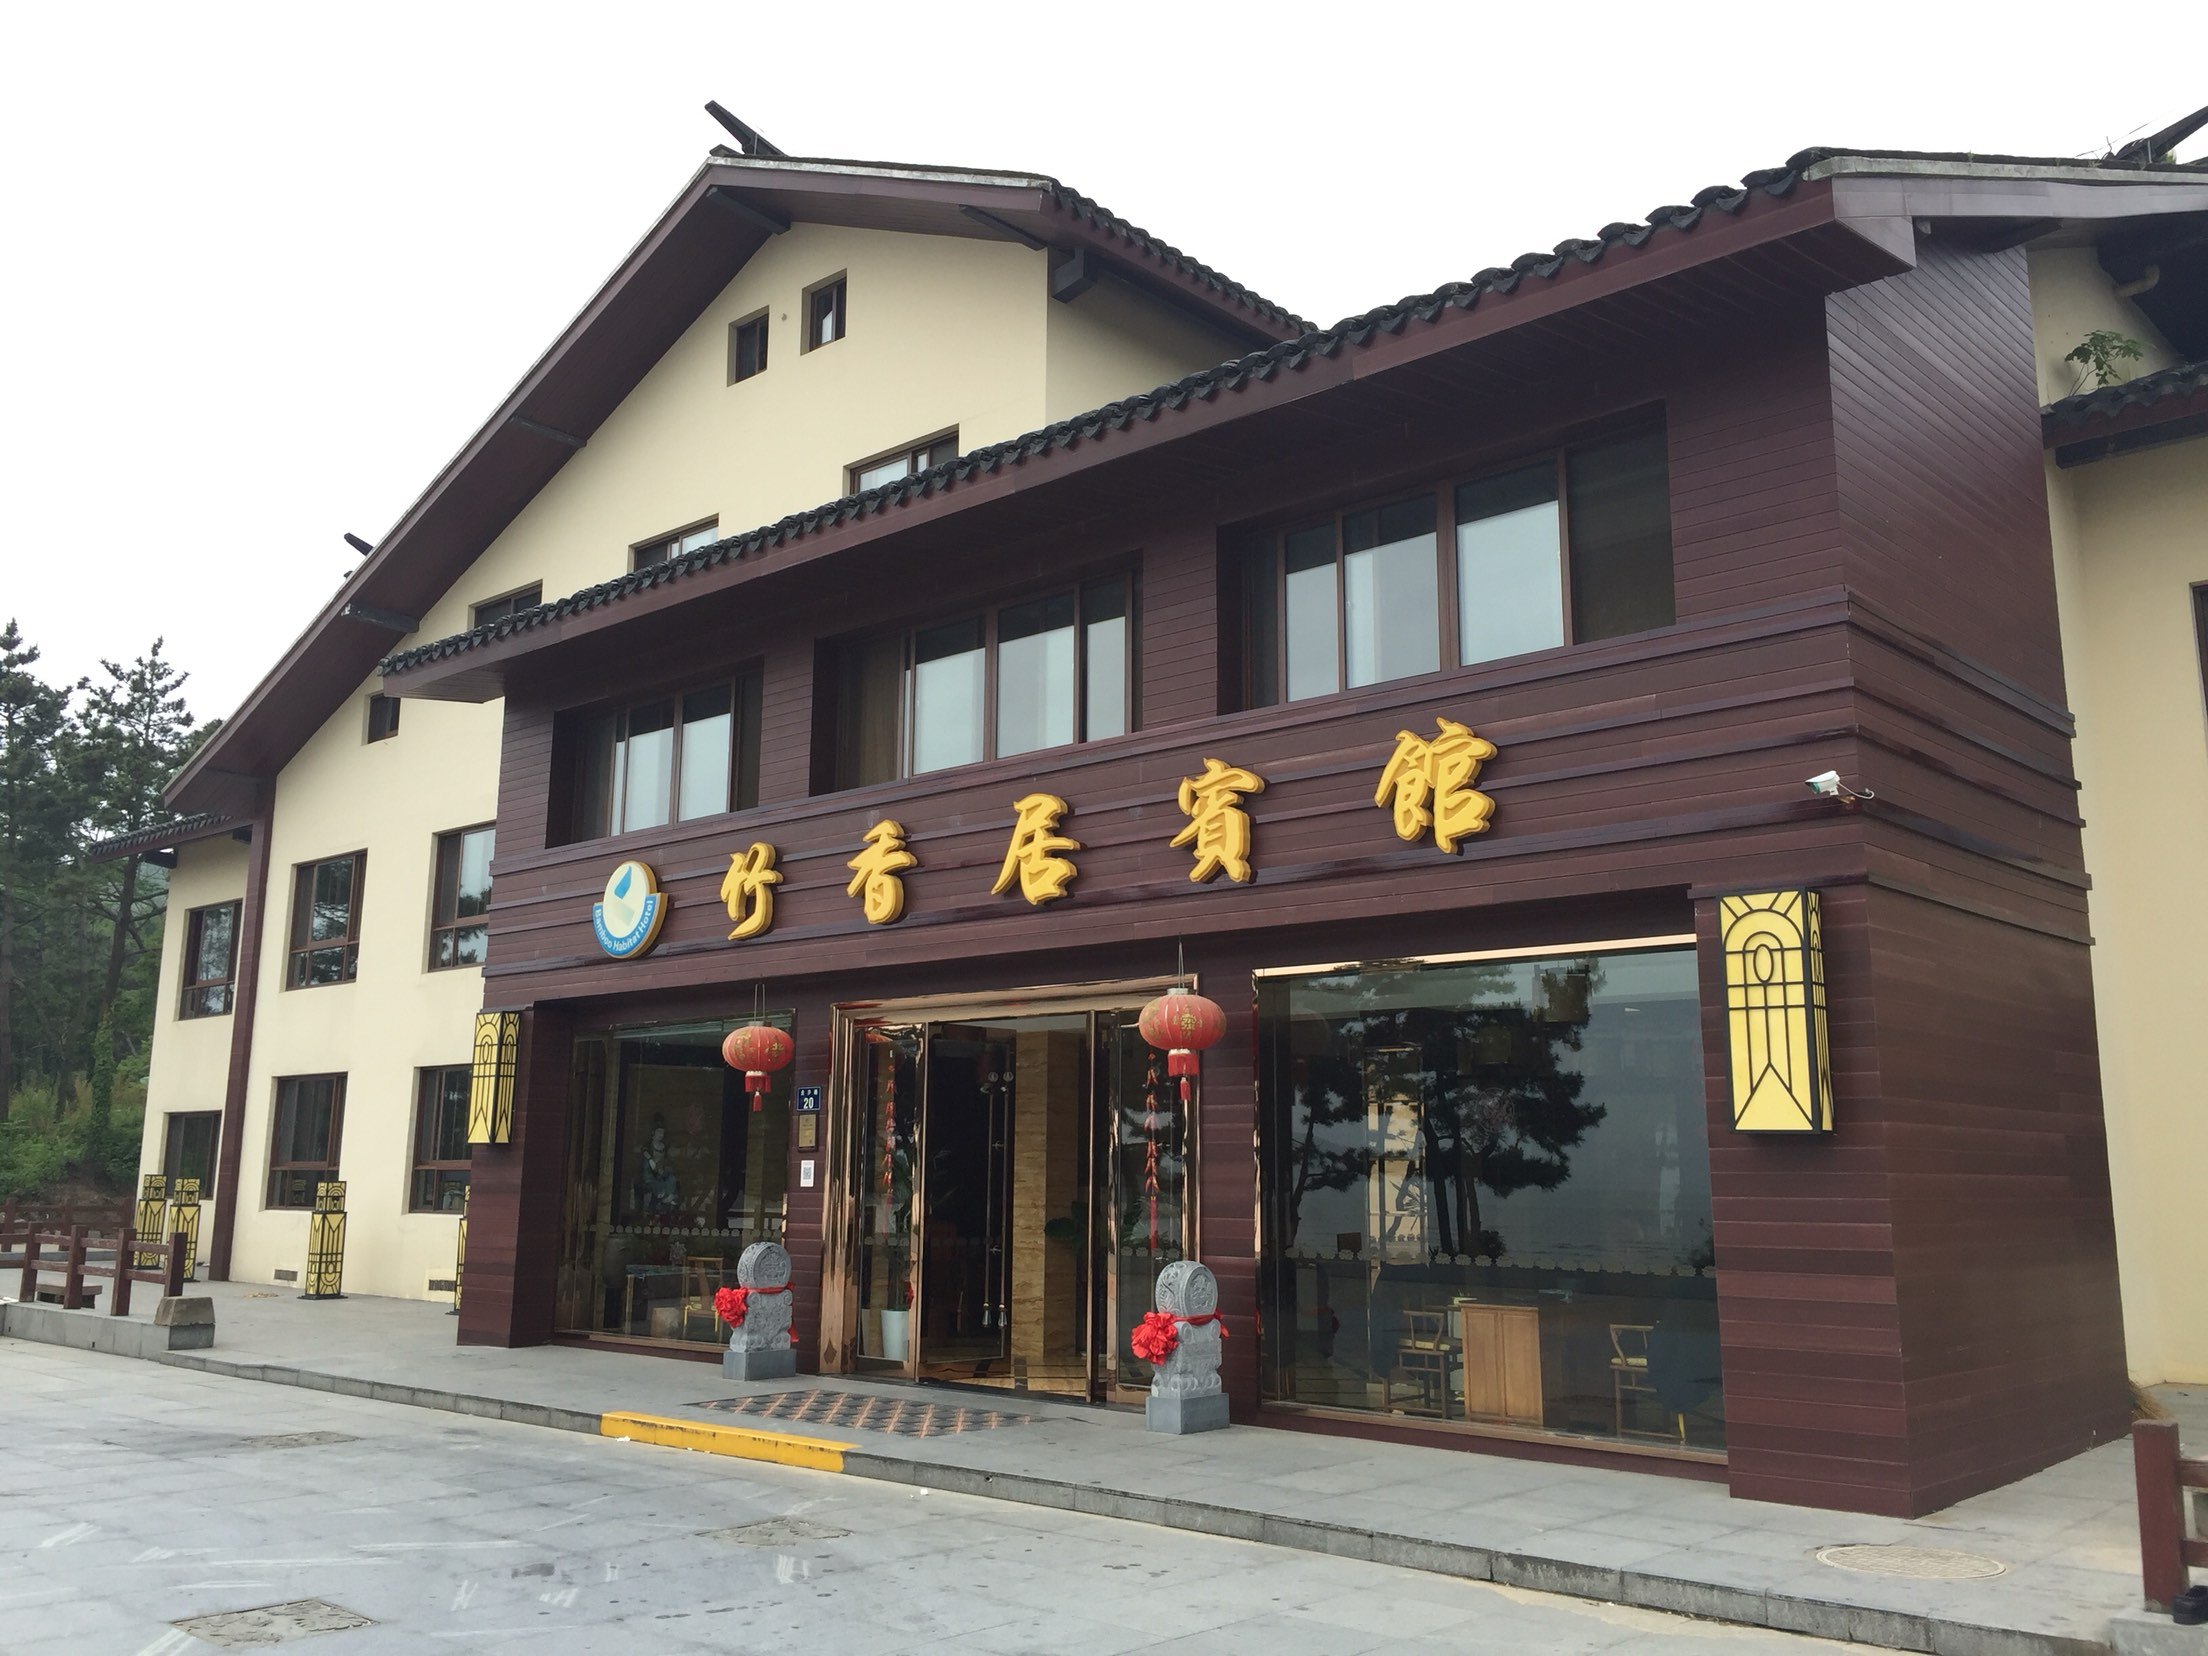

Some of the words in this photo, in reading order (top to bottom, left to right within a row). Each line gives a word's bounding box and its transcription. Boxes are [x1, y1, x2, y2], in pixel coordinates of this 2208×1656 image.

[595, 908, 612, 948] Bamboo
[613, 932, 640, 952] Habitat
[639, 900, 653, 933] Hotel
[803, 1096, 814, 1109] 20
